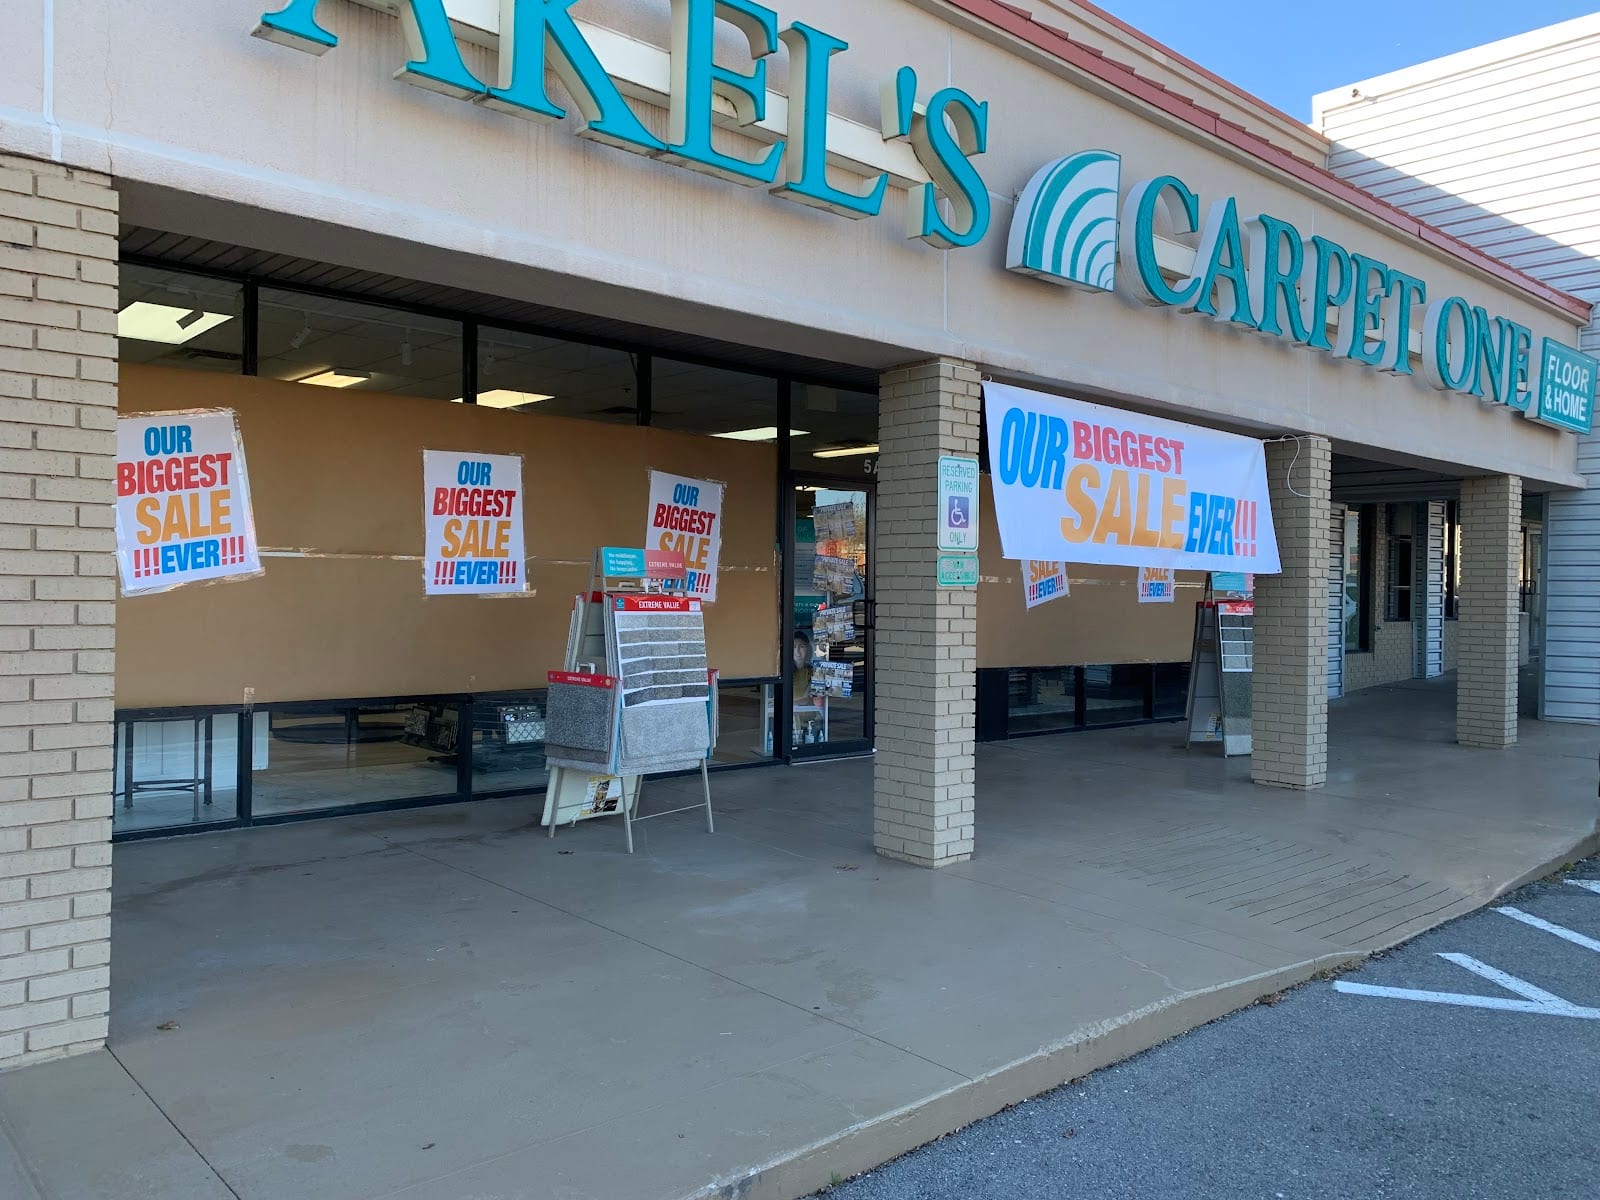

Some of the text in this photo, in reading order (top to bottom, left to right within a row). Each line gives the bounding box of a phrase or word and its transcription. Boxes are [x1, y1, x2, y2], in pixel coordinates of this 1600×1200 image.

[1135, 175, 1532, 411] CARPET ONE
[1547, 354, 1589, 394] FLOOR
[1545, 384, 1588, 422] & HOME
[144, 424, 193, 456] OUR
[1000, 407, 1185, 490] OUR BIGGEST
[117, 452, 232, 497] BIGGEST
[457, 460, 492, 487] OUR
[942, 464, 975, 479] RESERVED
[945, 479, 973, 494] PARKING
[433, 487, 517, 518] BIGGEST
[673, 483, 700, 507] OUR
[1060, 463, 1187, 550] SALE
[136, 488, 232, 545] SALE
[653, 503, 716, 536] BIGGEST
[440, 518, 512, 559] SALE
[949, 531, 968, 545] ONLY
[1030, 560, 1060, 583] SALE
[638, 600, 680, 609] EXTREME VALUE
